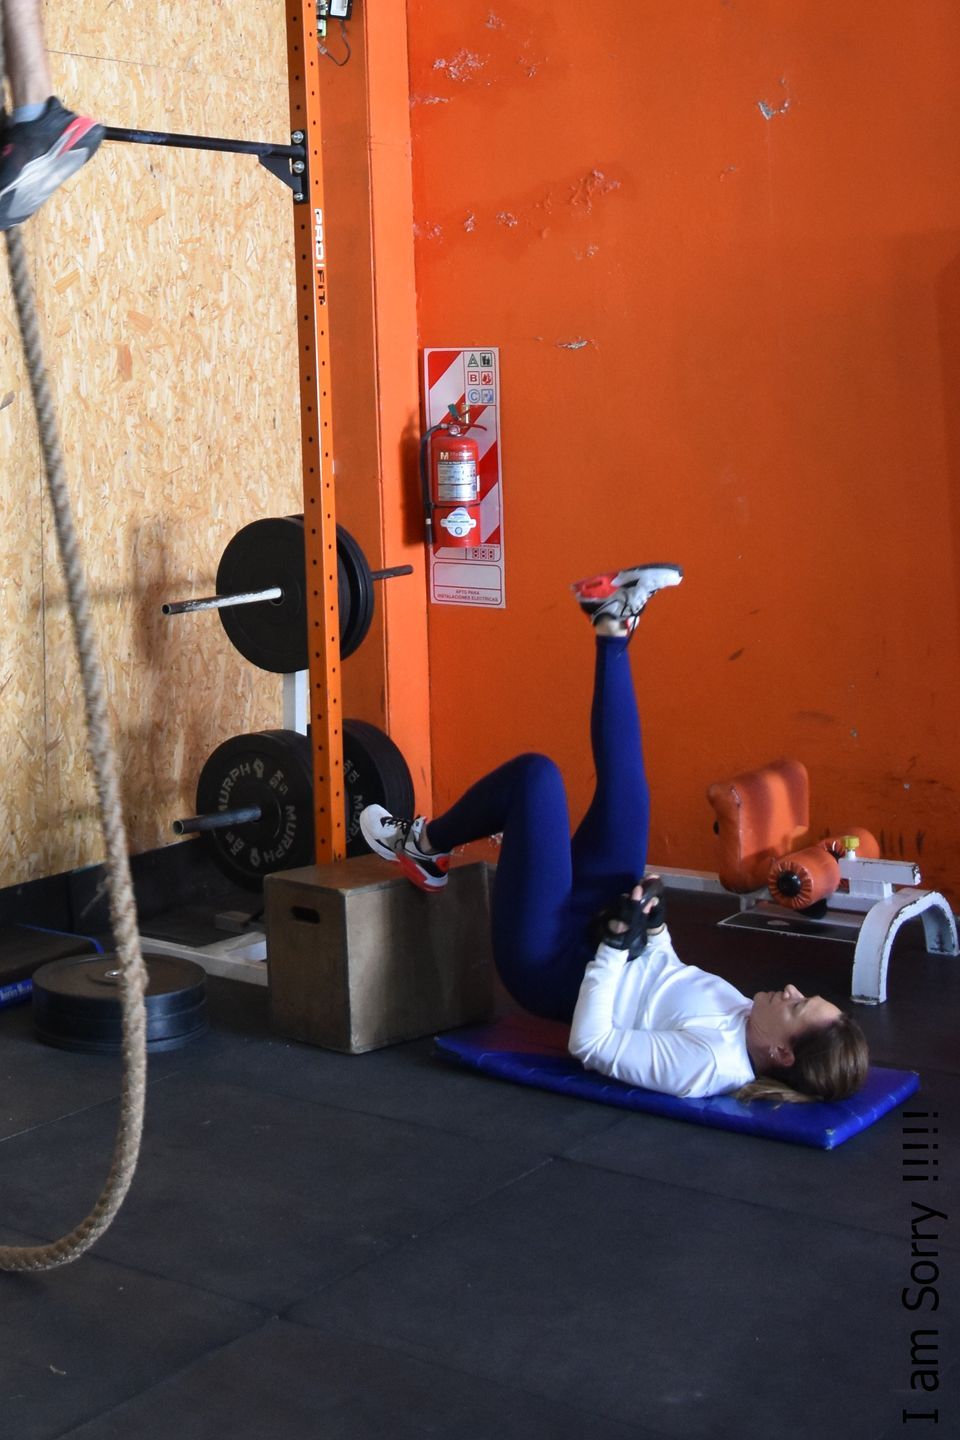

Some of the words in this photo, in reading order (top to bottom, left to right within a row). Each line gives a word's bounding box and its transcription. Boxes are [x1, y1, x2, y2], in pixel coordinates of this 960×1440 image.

[470, 374, 477, 382] B
[471, 391, 478, 401] C
[263, 805, 297, 863] MURPH
